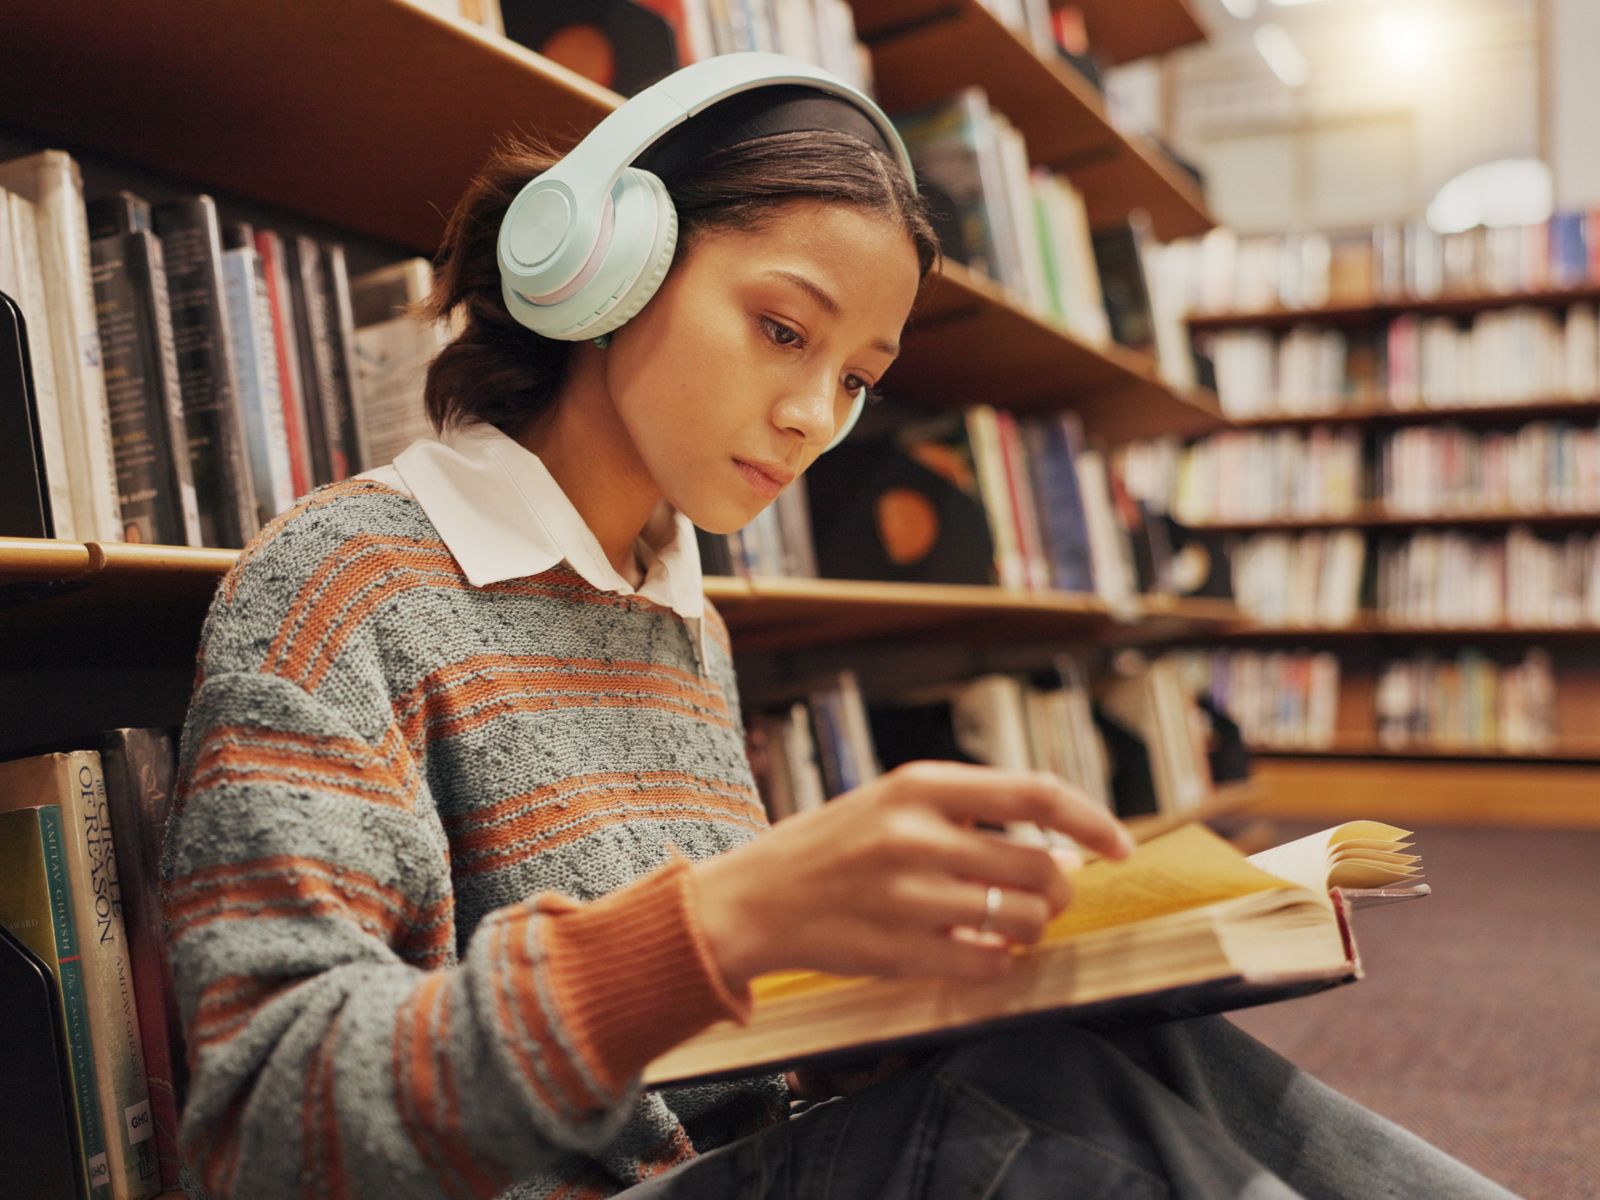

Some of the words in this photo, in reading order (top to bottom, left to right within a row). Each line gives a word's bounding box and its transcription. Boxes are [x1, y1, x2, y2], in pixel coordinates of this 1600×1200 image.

[78, 766, 97, 808] OF
[46, 819, 61, 881] AMITAV
[56, 888, 71, 949] GHOSH
[84, 814, 114, 944] REASON
[131, 1111, 149, 1129] GHO
